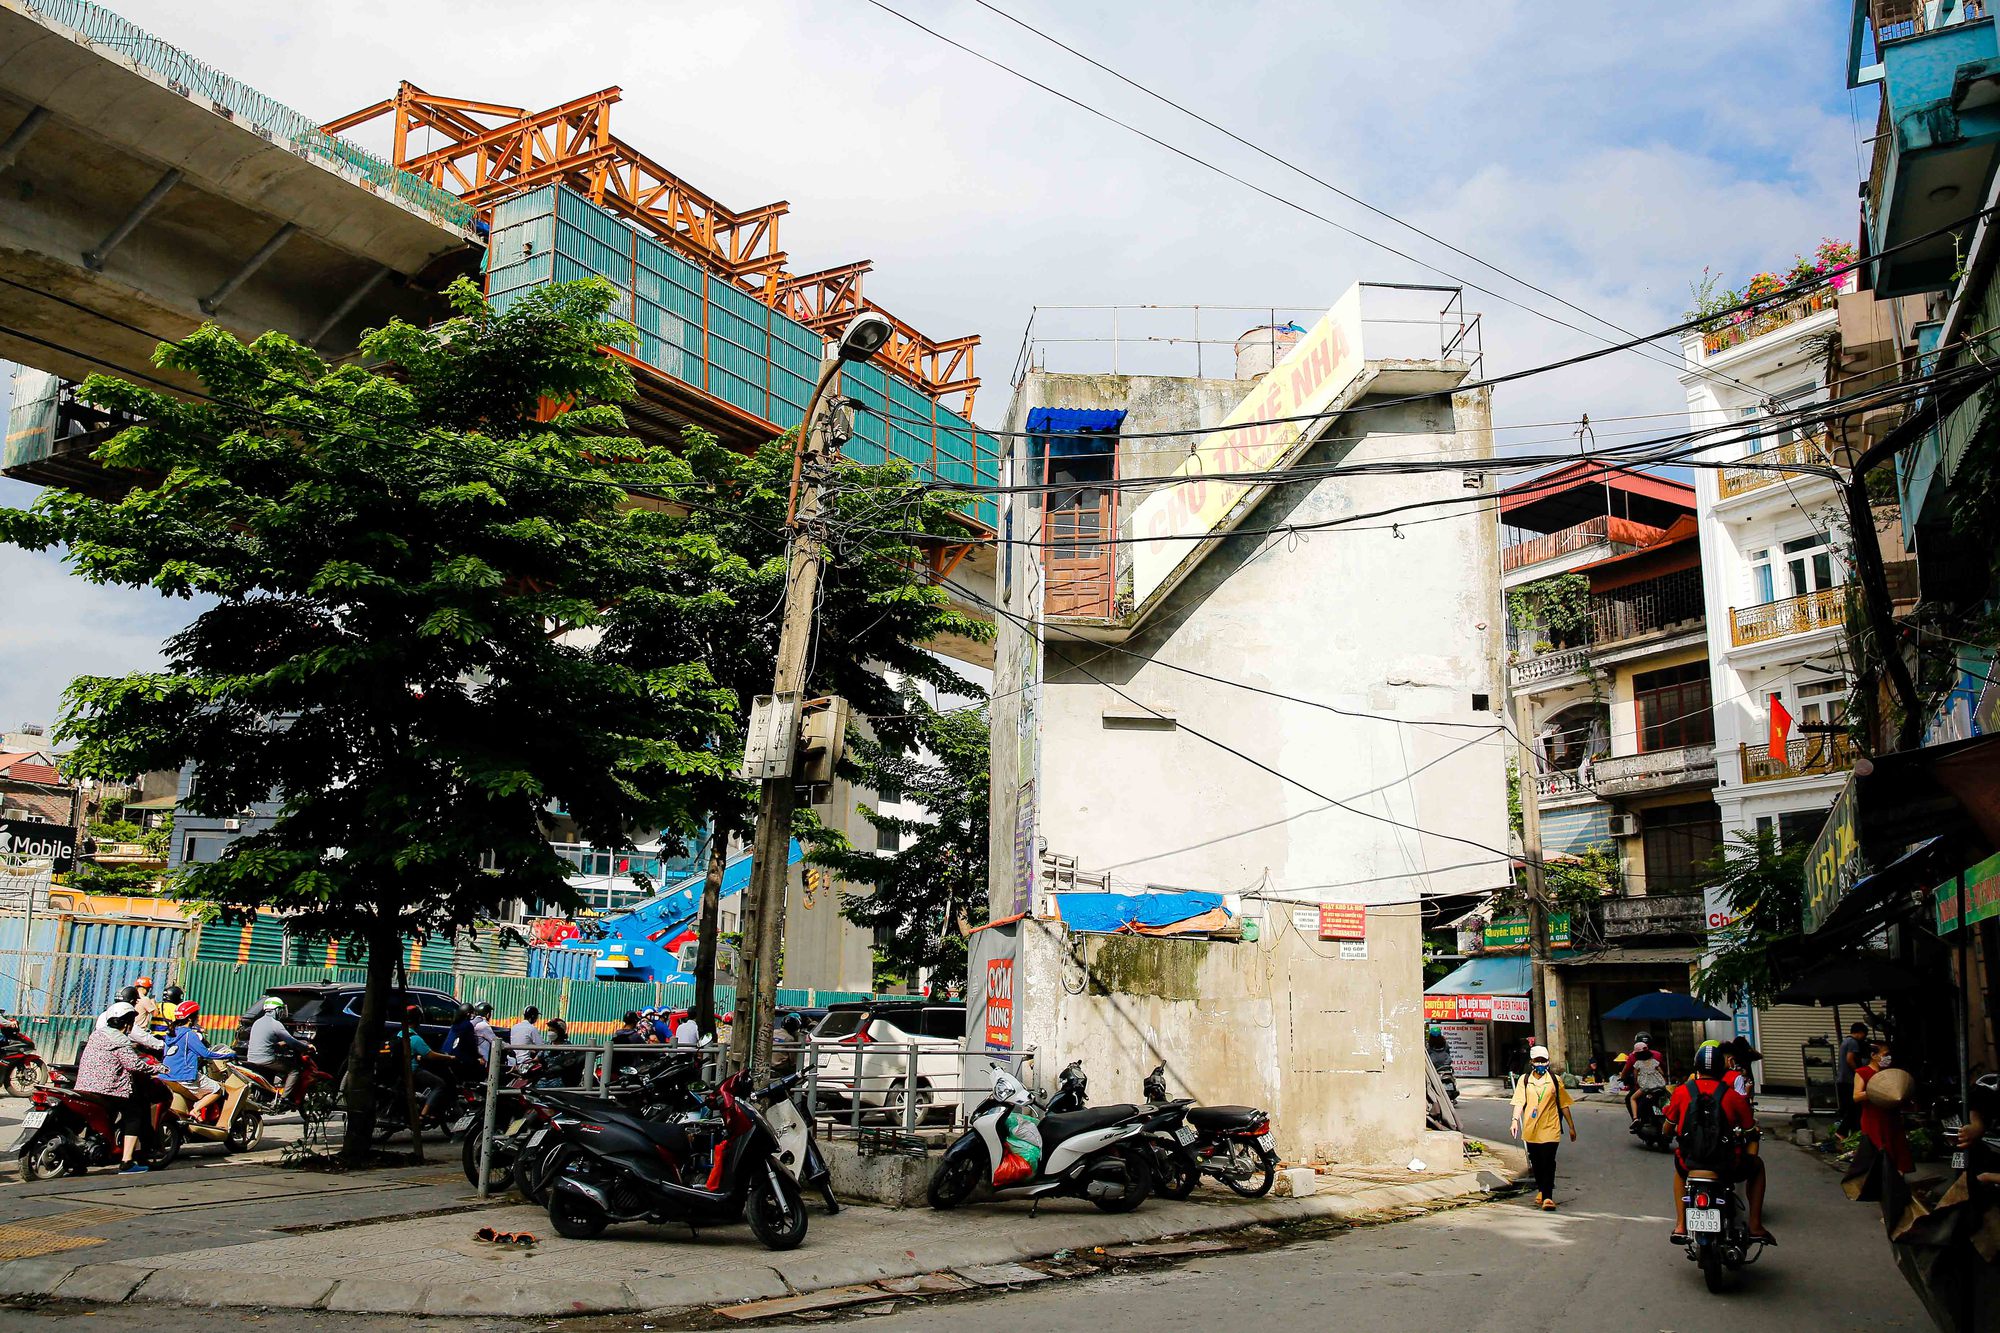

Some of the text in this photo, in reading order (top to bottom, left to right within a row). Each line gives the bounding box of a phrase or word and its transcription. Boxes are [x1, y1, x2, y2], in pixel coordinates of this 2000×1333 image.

[1148, 318, 1350, 556] CHO THUÊ NHÀ
[13, 836, 72, 859] Mobile
[988, 961, 1012, 1000] CƠM
[1431, 1009, 1449, 1018] 24/7
[1461, 1009, 1472, 1018] LẤY
[1497, 1011, 1509, 1020] GIÁ
